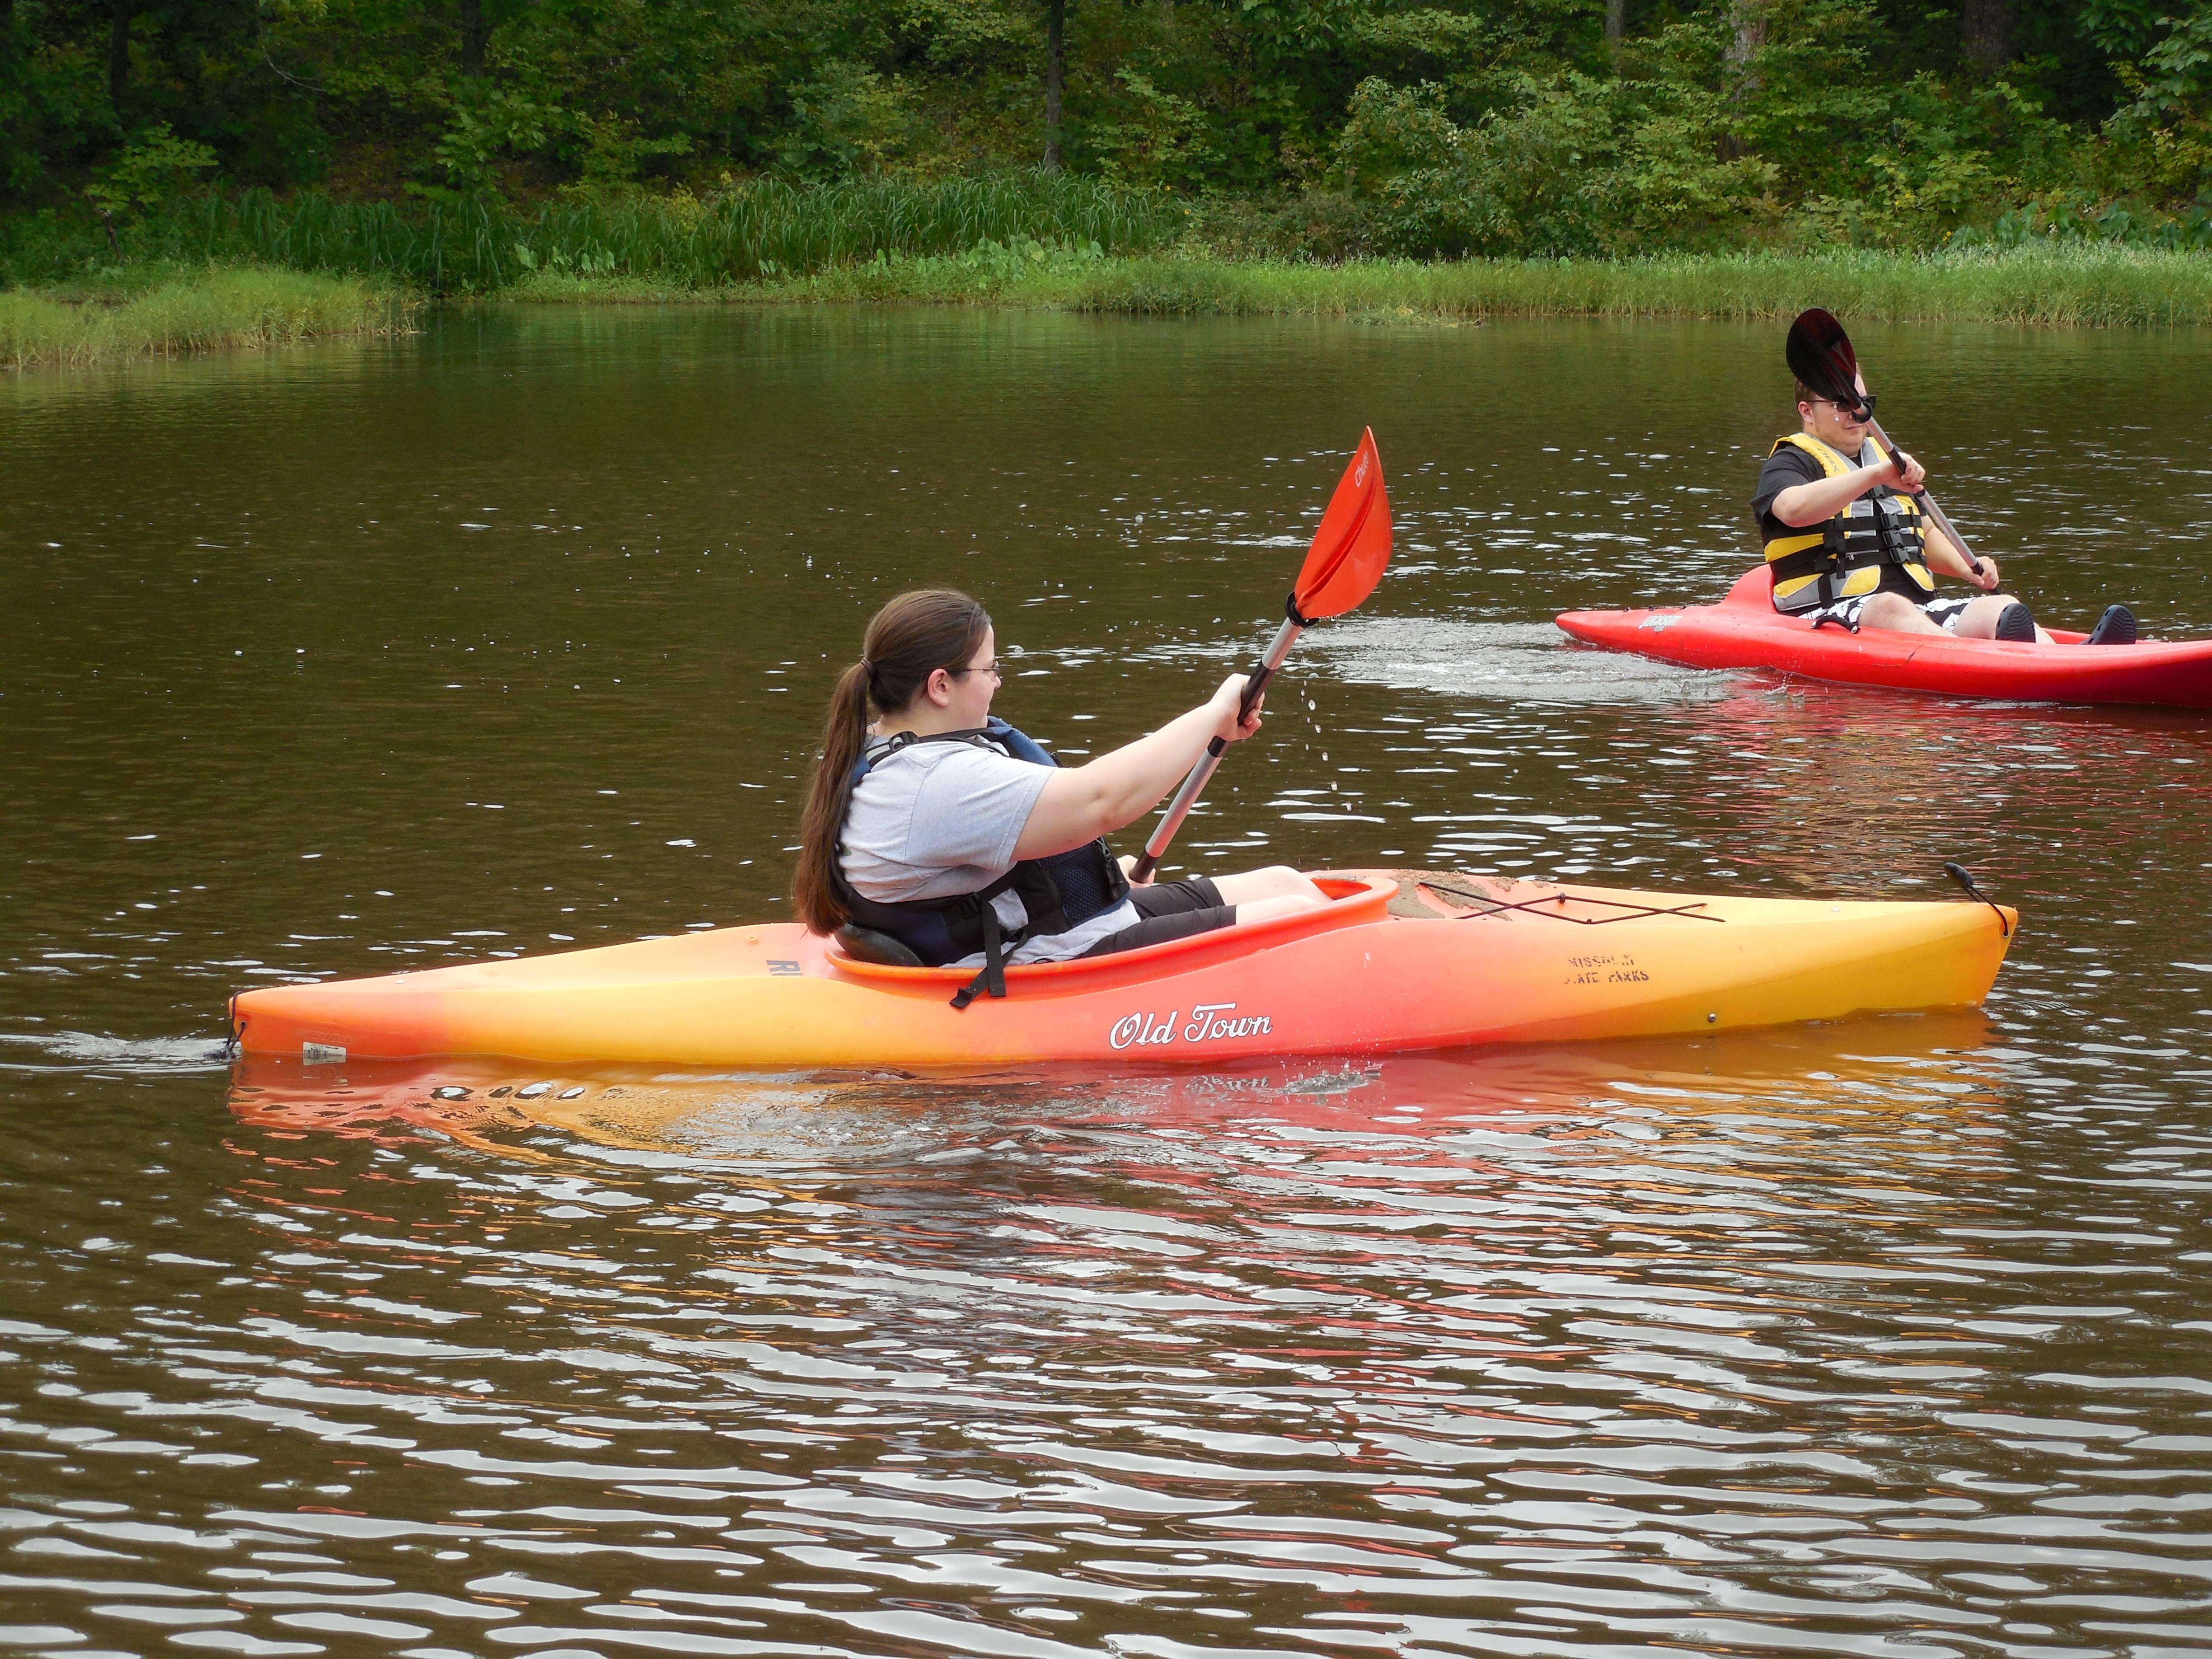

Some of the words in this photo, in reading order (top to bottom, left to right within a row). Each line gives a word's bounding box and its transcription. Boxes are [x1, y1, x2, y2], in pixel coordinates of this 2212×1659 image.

[1569, 954, 1634, 967] MISSI
[1564, 972, 1599, 984] ATE
[1110, 1010, 1178, 1050] Old
[1183, 1002, 1273, 1042] Town
